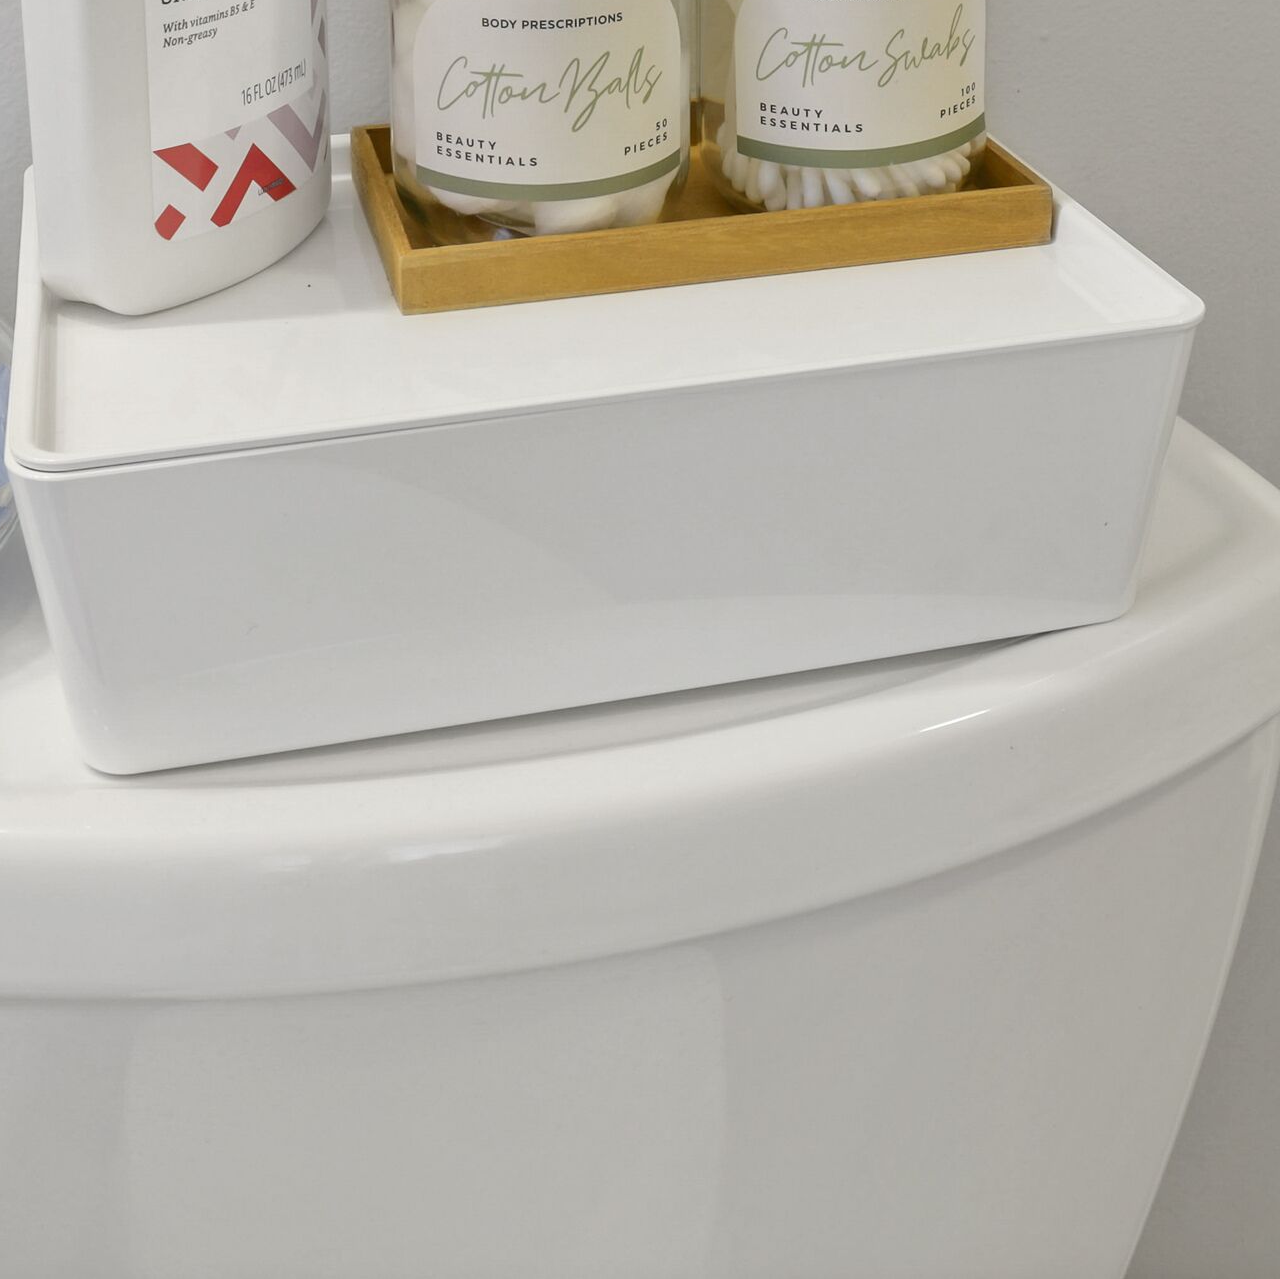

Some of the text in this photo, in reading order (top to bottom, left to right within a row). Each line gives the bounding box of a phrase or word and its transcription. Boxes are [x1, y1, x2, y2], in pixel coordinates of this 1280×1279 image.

[163, 19, 188, 34] With
[190, 10, 229, 27] vitamins
[229, 4, 240, 17] B5
[241, 2, 249, 12] &
[482, 12, 623, 30] BODY PRESCRIPTIONS
[163, 27, 218, 49] Non-greasy
[756, 3, 976, 88] Cotton Swabs
[242, 87, 252, 106] 16
[253, 83, 264, 101] FL
[265, 76, 277, 96] OZ
[278, 67, 293, 92] (473
[437, 45, 662, 133] Cotton Balls
[961, 82, 976, 97] 100
[760, 102, 823, 118] BEAUTY
[940, 95, 976, 118] PIECES
[656, 118, 668, 131] 50
[760, 116, 863, 133] ESSENTIALS
[436, 131, 496, 150] BEAUTY
[624, 132, 668, 156] PIECES
[437, 145, 538, 167] ESSENTIALS
